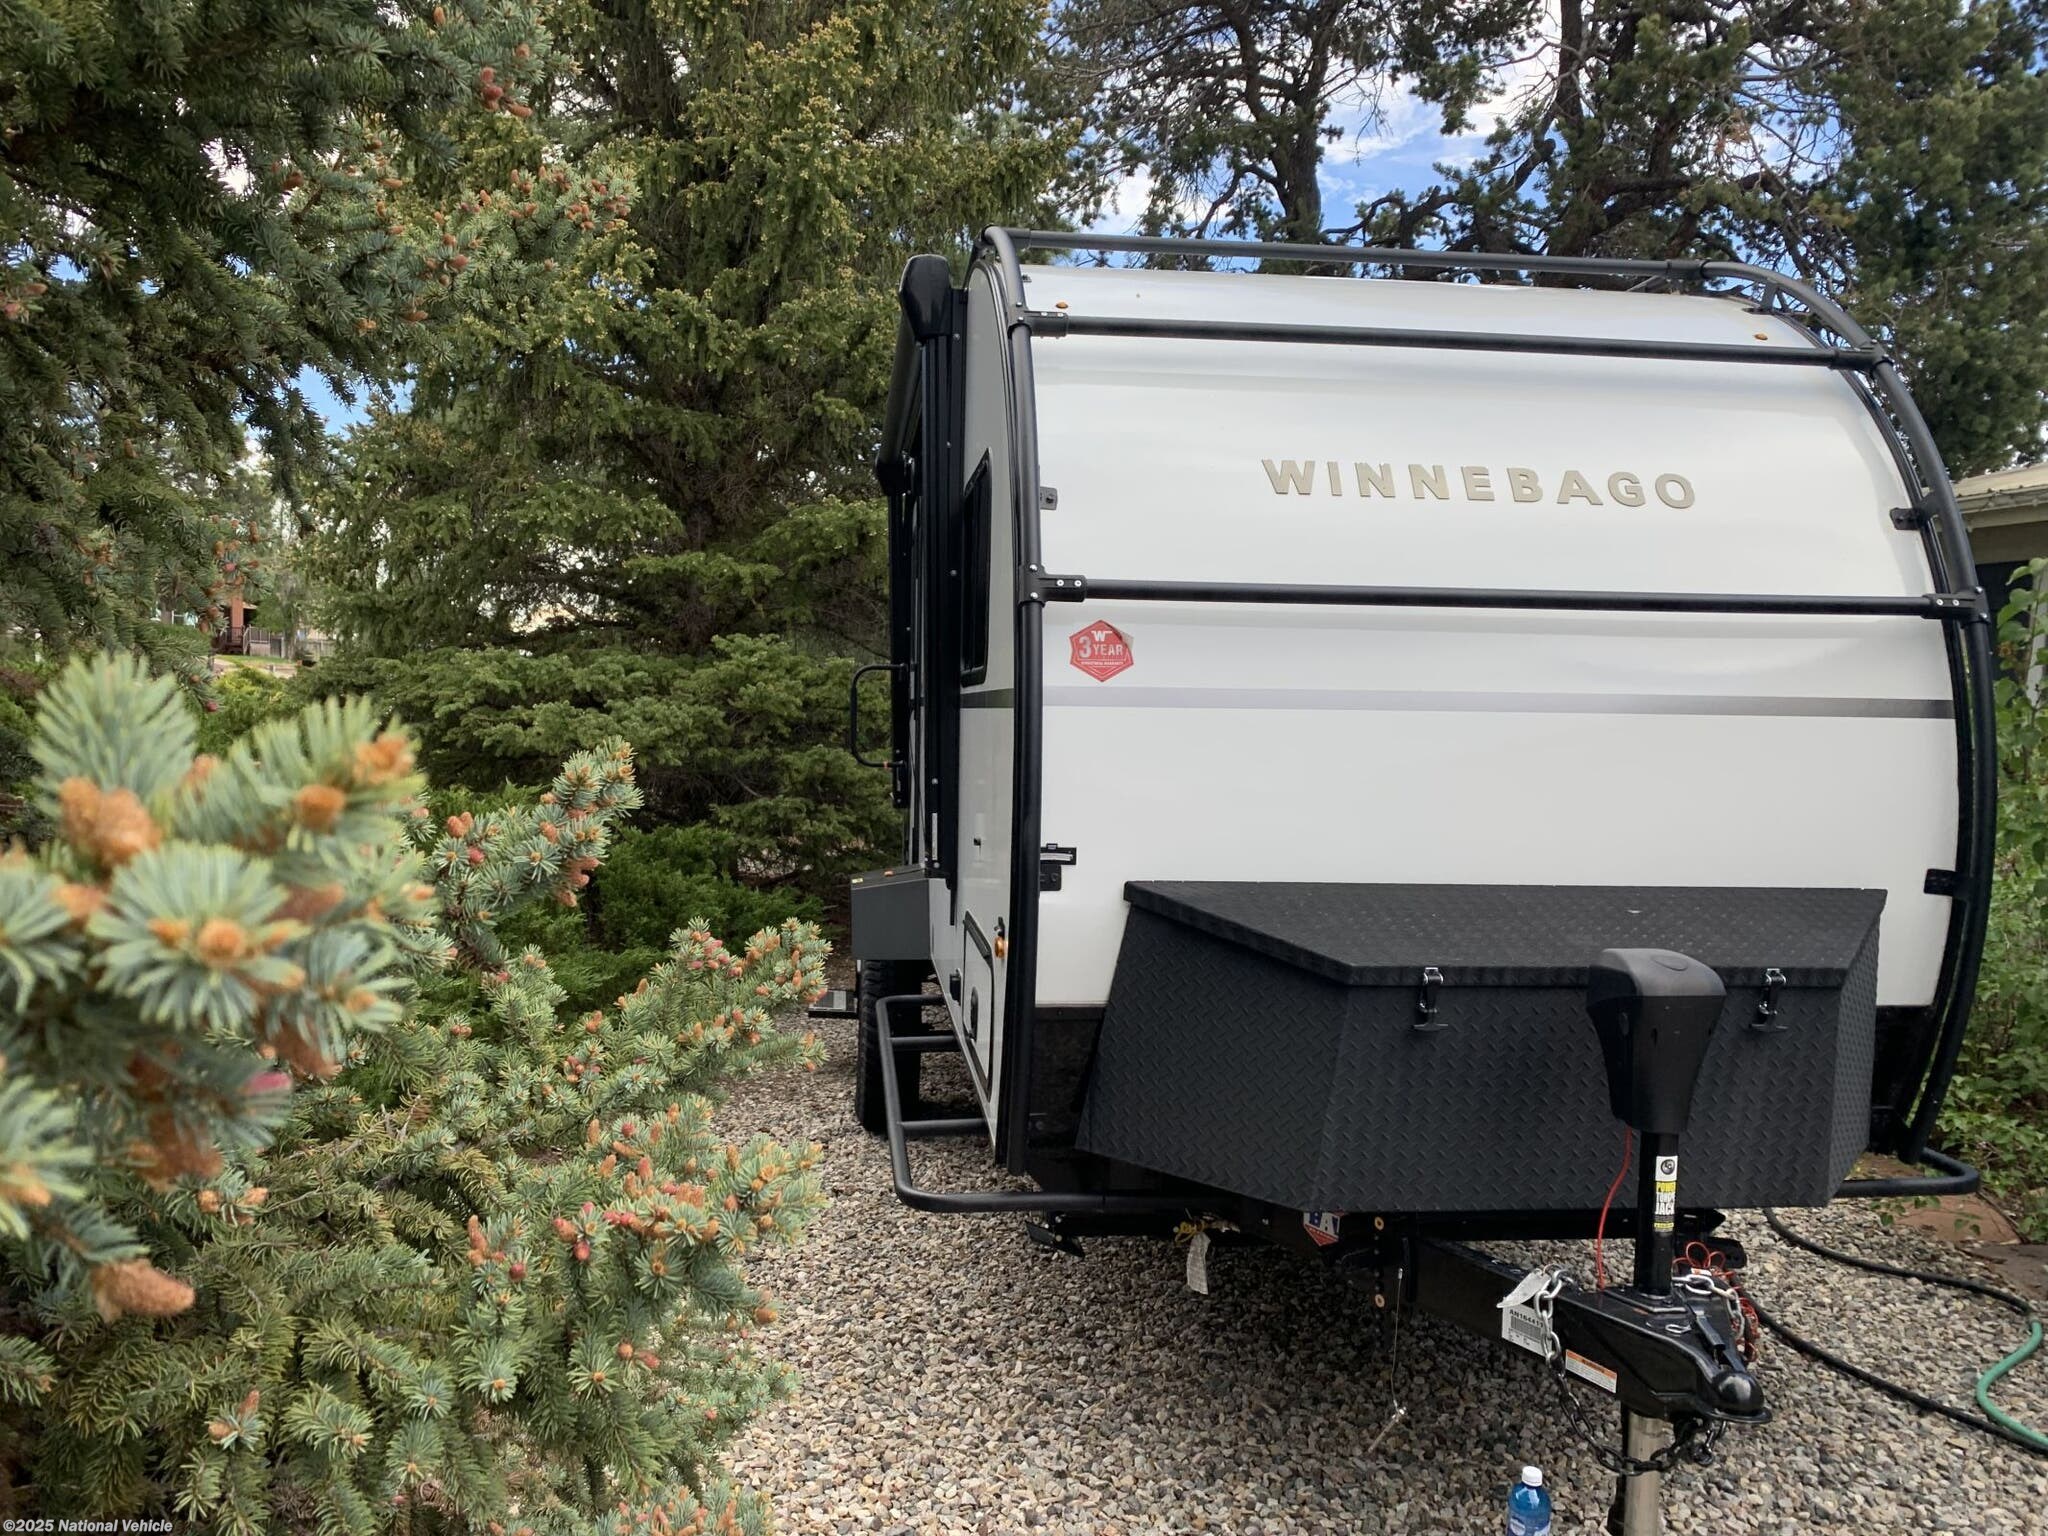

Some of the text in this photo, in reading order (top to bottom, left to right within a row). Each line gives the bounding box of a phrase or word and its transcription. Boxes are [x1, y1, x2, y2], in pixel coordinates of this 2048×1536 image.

[1261, 458, 1696, 509] WINNEBAGO
[1079, 635, 1123, 658] 3 YEAR
